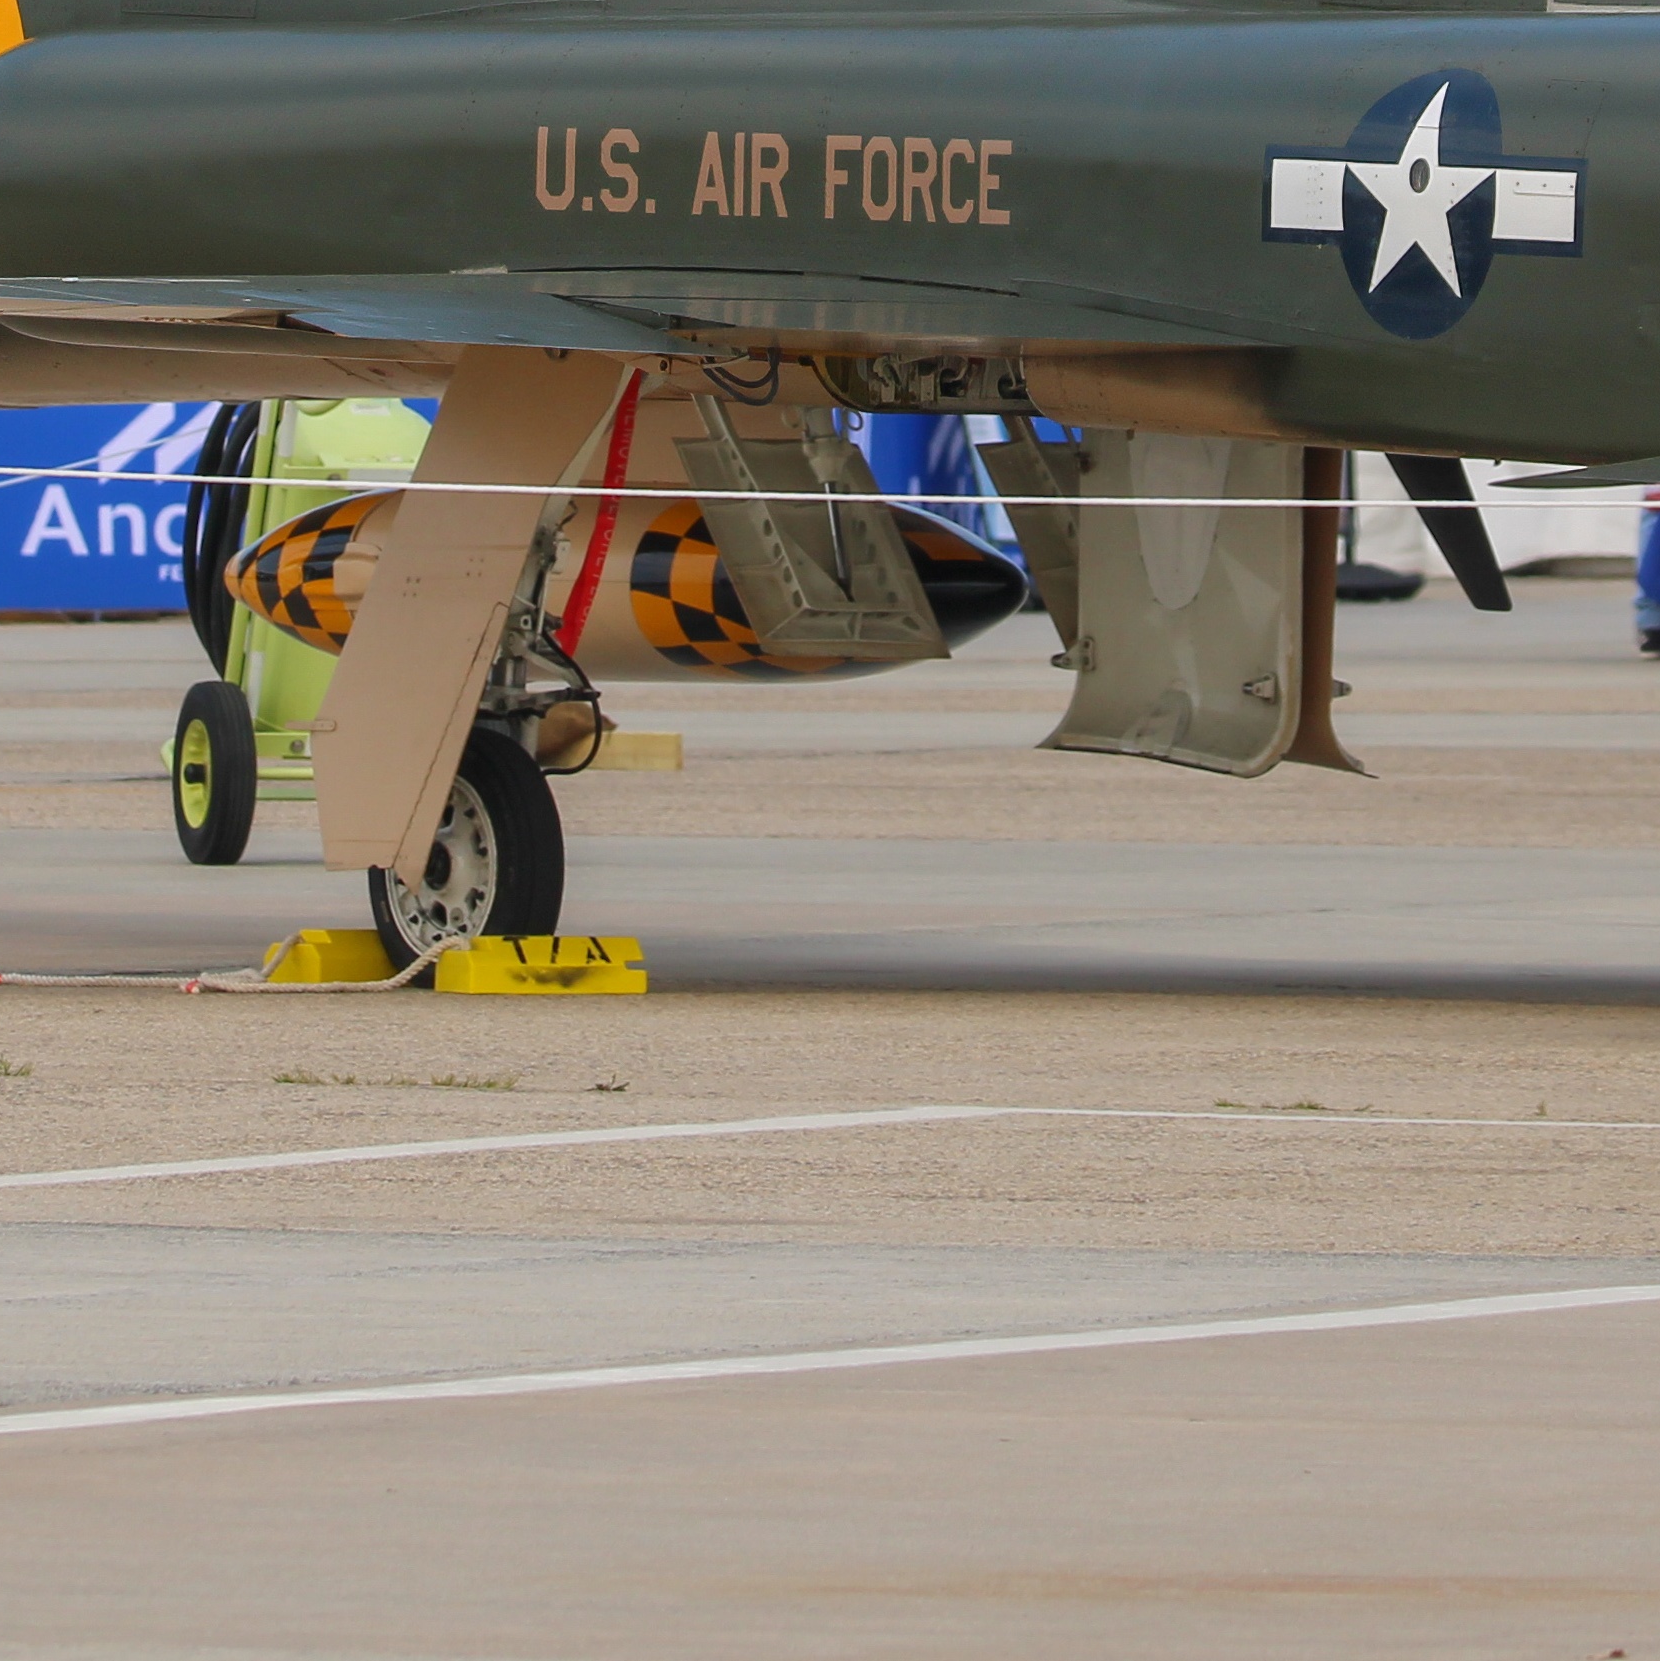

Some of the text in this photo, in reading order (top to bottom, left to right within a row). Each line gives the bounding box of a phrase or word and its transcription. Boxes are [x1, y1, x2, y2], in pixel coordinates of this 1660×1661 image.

[535, 126, 1013, 226] U.S. AIR FORCE
